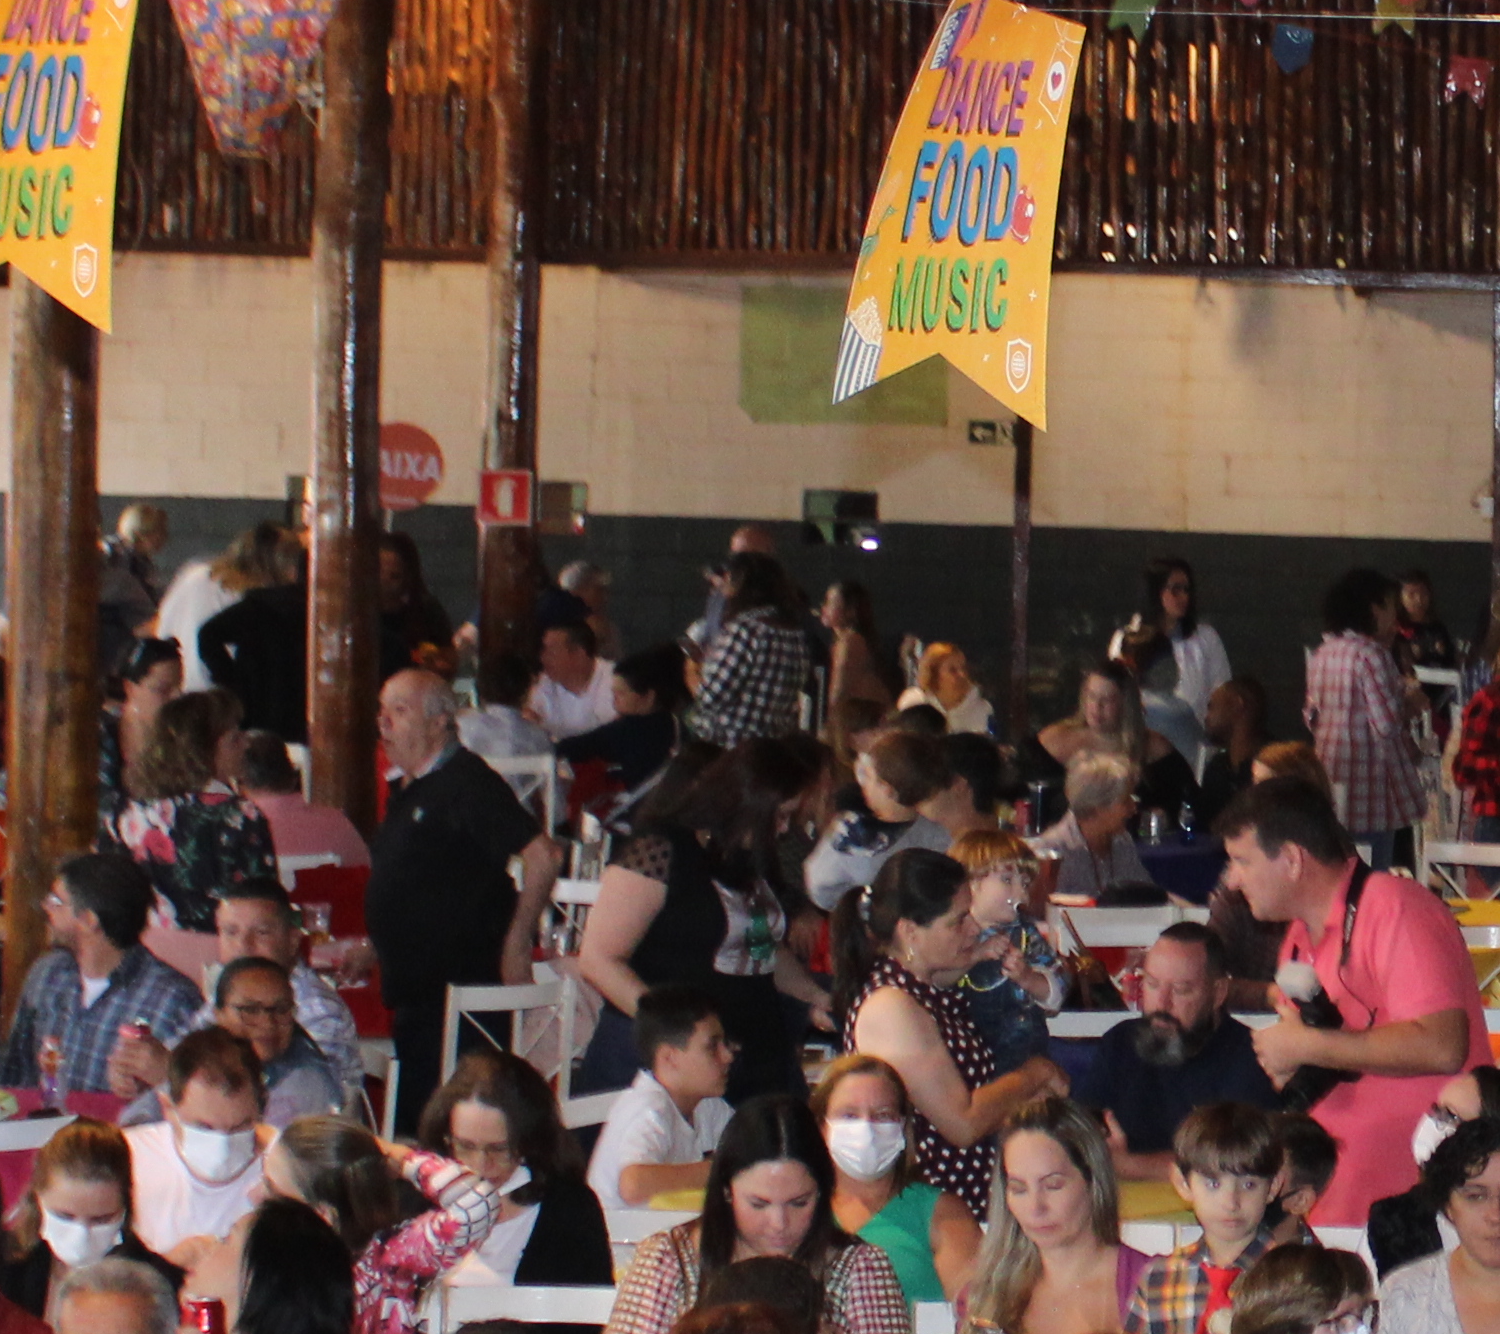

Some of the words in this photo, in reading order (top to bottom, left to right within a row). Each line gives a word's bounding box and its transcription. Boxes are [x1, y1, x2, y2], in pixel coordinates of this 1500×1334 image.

[927, 56, 1036, 137] DANCE
[902, 139, 1018, 247] FOOD
[887, 255, 1008, 335] MUSIC
[380, 449, 441, 482] AIXA
